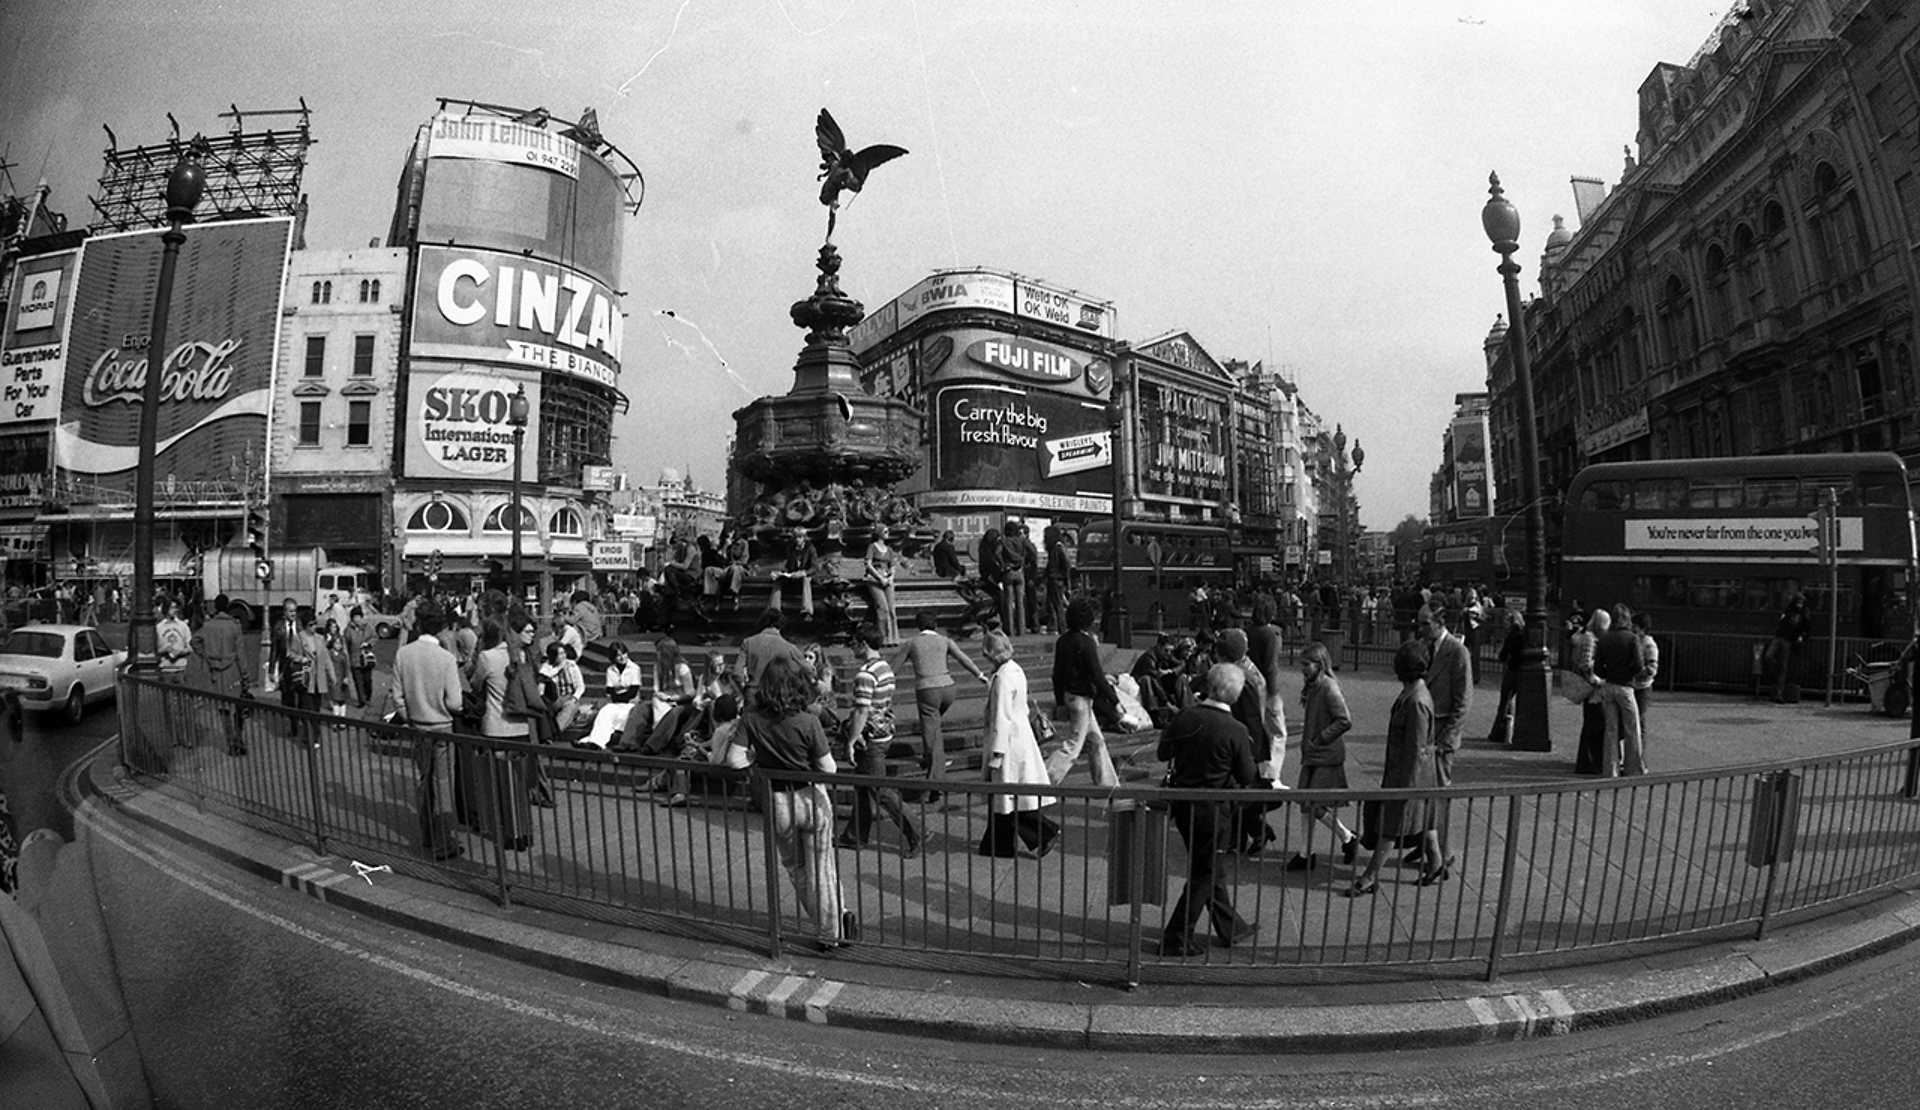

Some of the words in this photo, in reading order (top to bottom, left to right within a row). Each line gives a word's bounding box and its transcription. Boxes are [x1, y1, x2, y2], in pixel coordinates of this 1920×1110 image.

[435, 116, 484, 140] John
[921, 283, 968, 305] BWIA
[1023, 286, 1051, 304] Weld
[1054, 294, 1069, 309] OK
[21, 301, 55, 314] MOPAR
[1024, 301, 1042, 316] OK
[1045, 307, 1070, 324] Weld
[123, 333, 152, 349] Enjo
[1, 344, 62, 367] Guaranteed
[519, 344, 558, 364] THE
[984, 341, 1029, 371] FUJI
[1033, 350, 1071, 378] FILM
[14, 367, 43, 382] Parts
[5, 385, 23, 401] For
[26, 383, 50, 399] Your
[15, 402, 35, 418] Car
[953, 398, 1003, 426] Carry
[1004, 402, 1026, 425] the
[1027, 405, 1048, 434] big
[961, 421, 1000, 444] fresh
[1001, 424, 1039, 449] flavour
[442, 445, 508, 463] LAGER
[1647, 525, 1677, 540] You're
[1678, 527, 1705, 540] never
[1705, 526, 1720, 540] far
[1720, 525, 1745, 540] from
[1747, 525, 1763, 540] the
[1763, 527, 1782, 540] one
[1782, 527, 1801, 542] you
[600, 546, 622, 554] EROS
[594, 557, 628, 566] CINEMA
